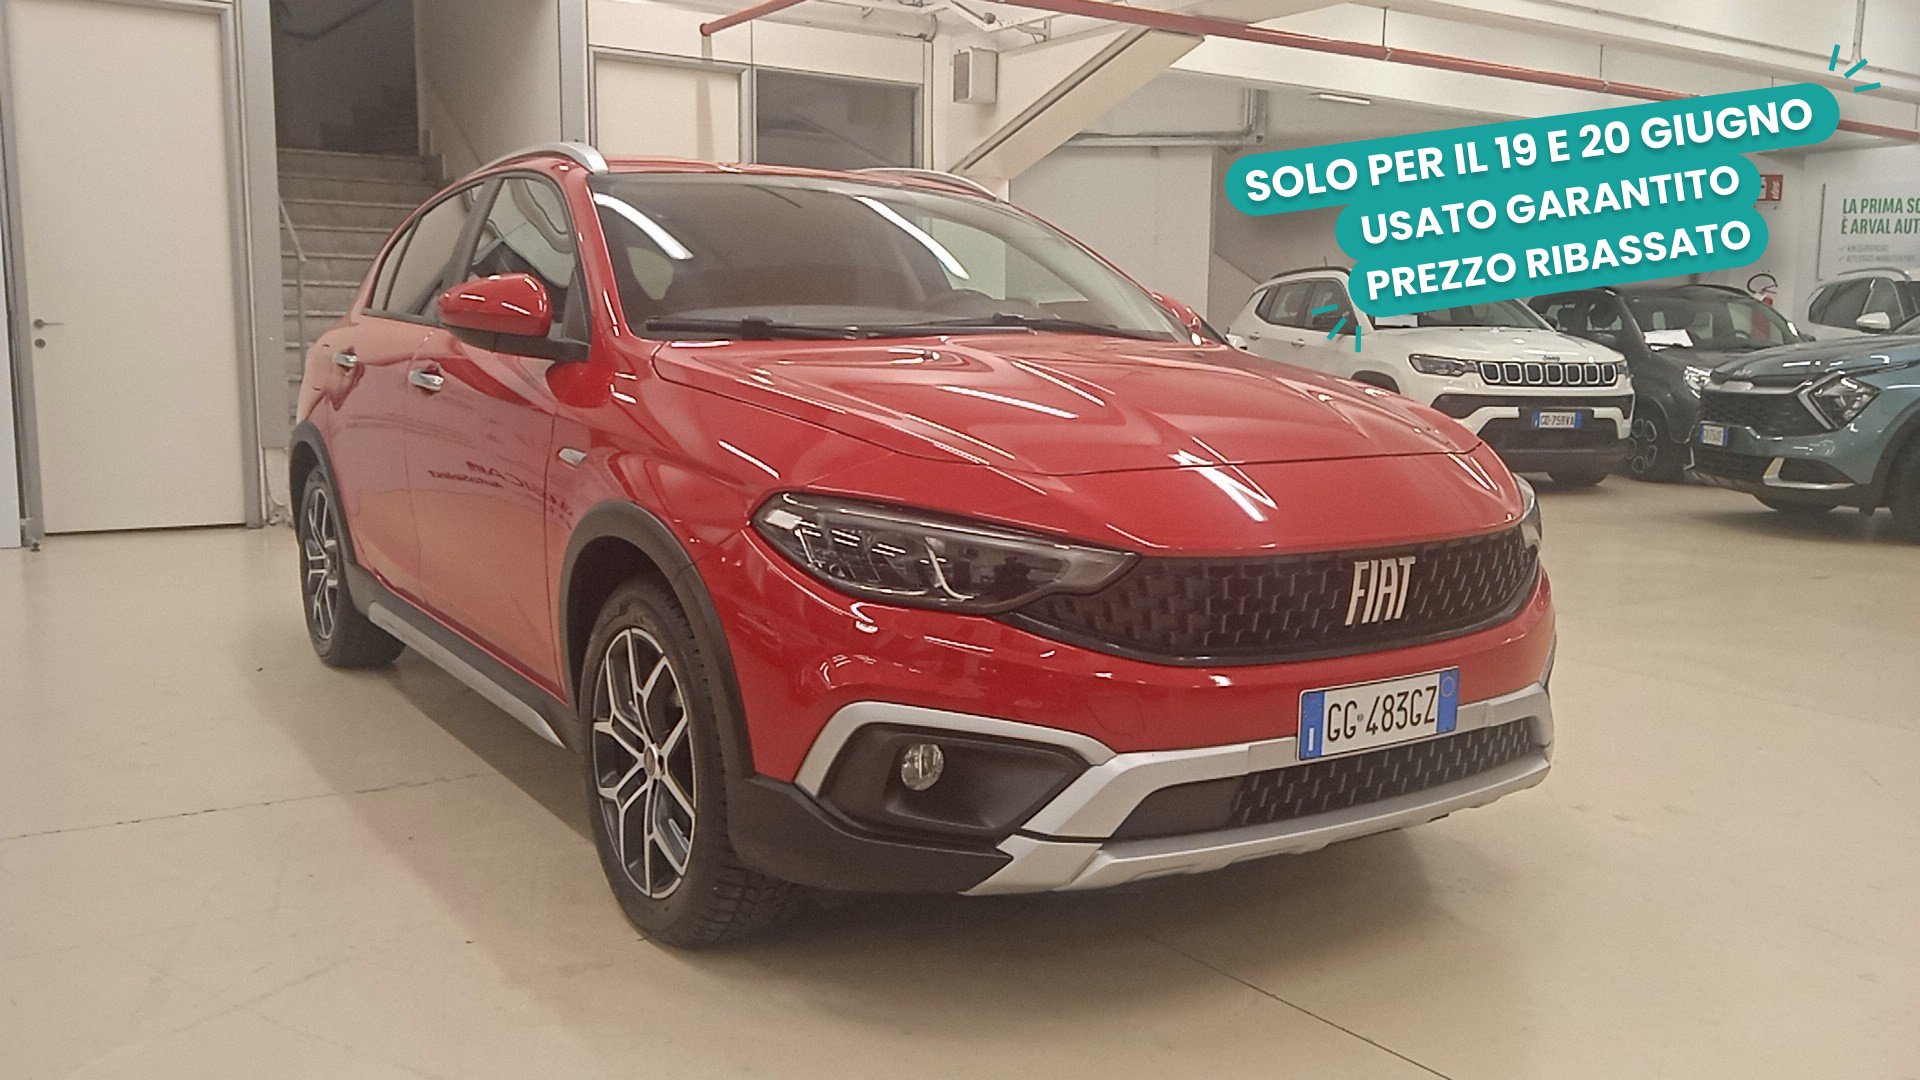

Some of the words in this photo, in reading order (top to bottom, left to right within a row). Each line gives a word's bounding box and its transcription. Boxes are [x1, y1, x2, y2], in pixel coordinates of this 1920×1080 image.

[1842, 198, 1857, 214] LA
[1860, 198, 1903, 214] PRIMA
[1850, 218, 1891, 234] ARVAL
[1344, 556, 1416, 626] FIAT
[1327, 700, 1357, 742] GG
[1366, 685, 1437, 735] 483GZ
